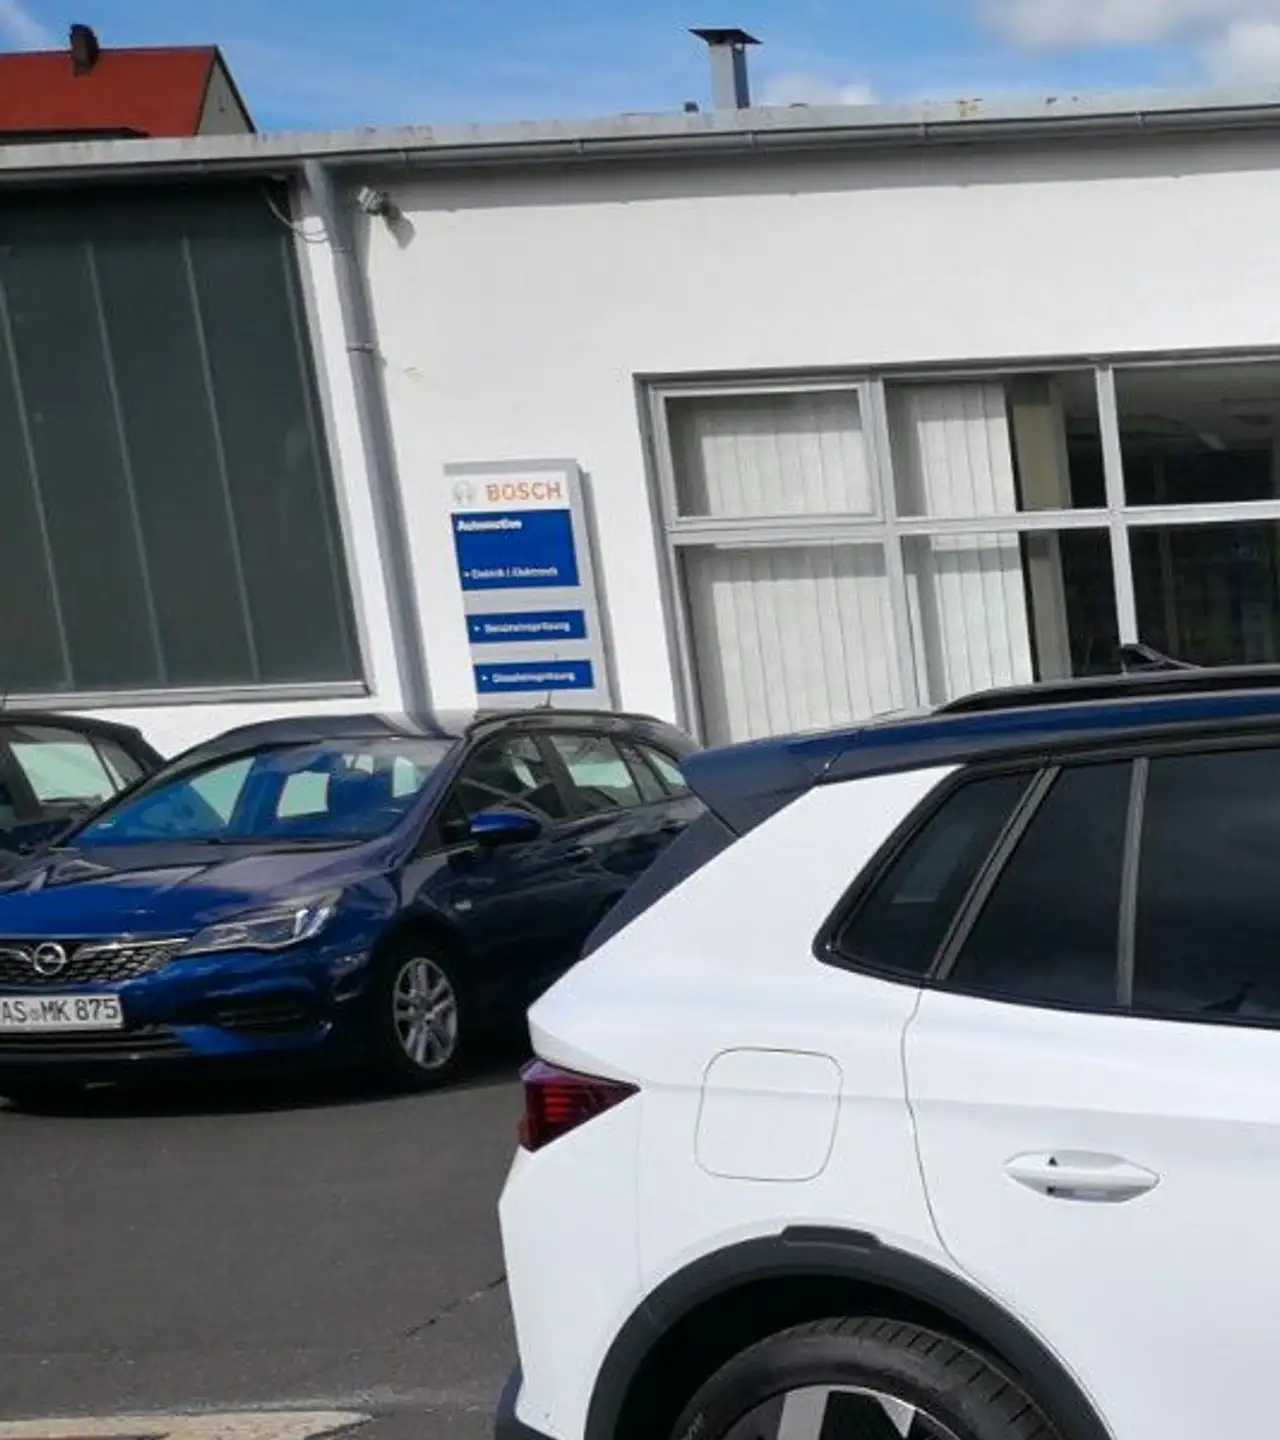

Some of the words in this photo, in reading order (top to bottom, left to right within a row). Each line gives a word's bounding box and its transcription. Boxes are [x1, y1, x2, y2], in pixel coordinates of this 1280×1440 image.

[485, 481, 562, 502] BOSCH
[1, 1000, 28, 1023] AS
[40, 999, 71, 1022] MK
[75, 998, 120, 1021] 875
